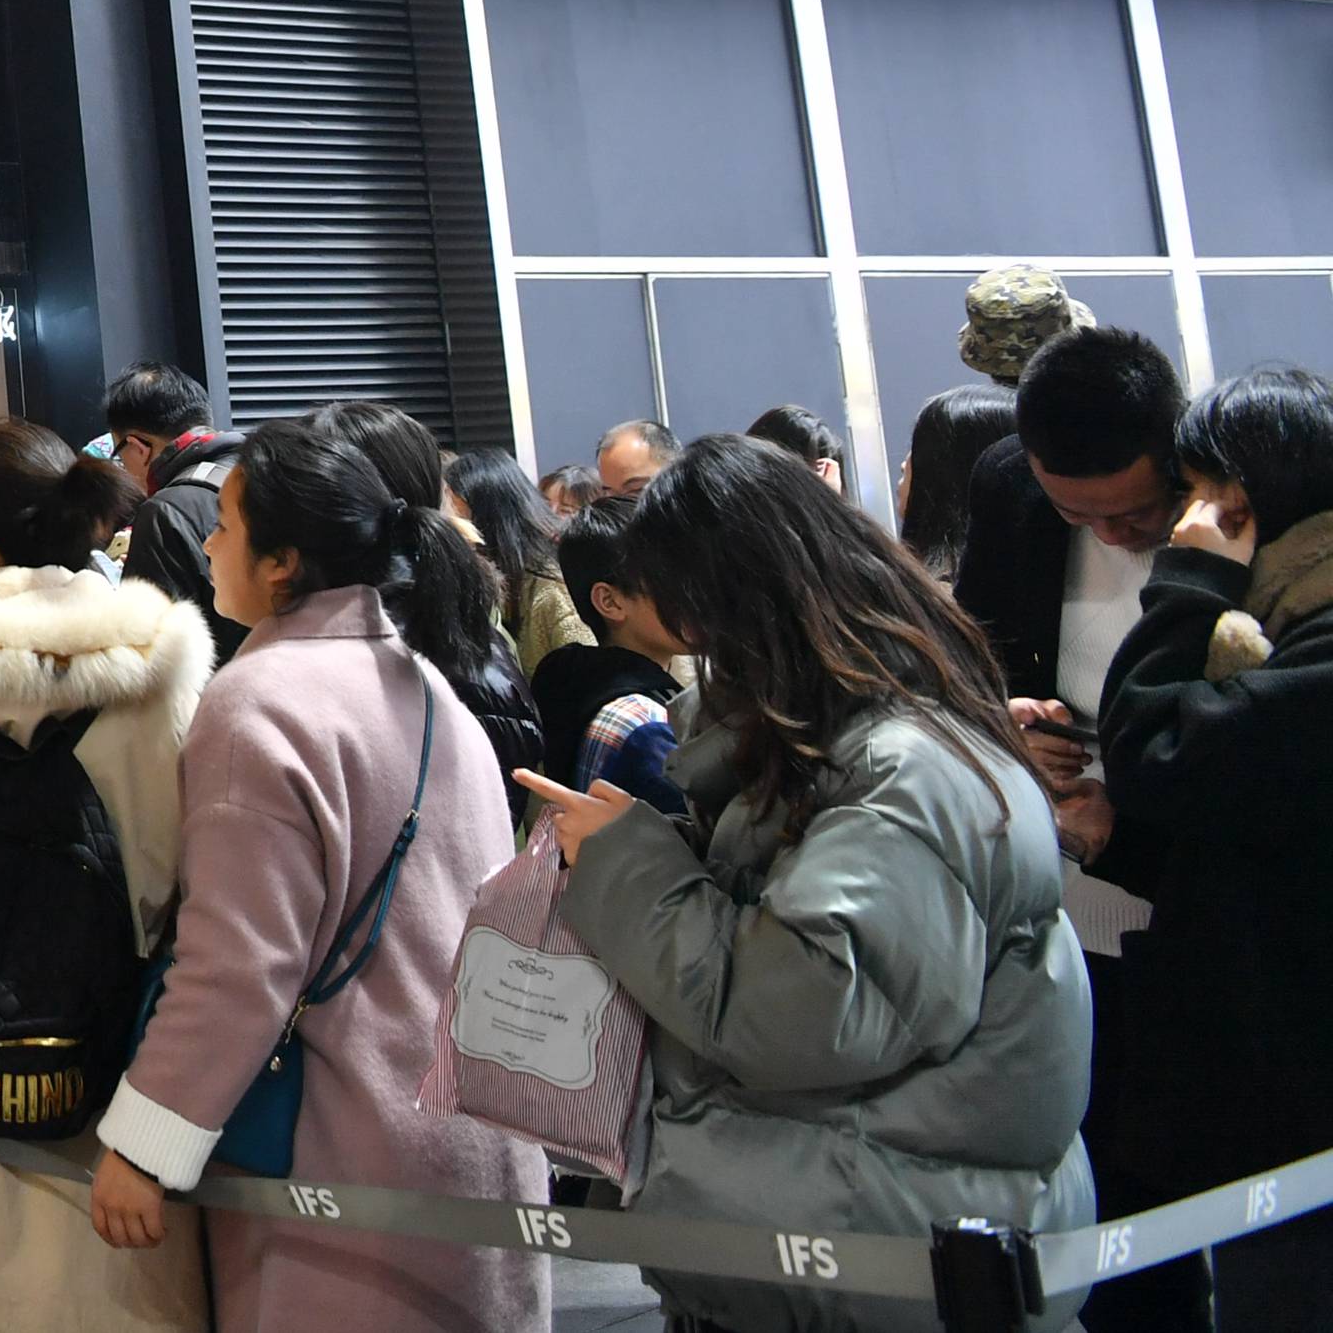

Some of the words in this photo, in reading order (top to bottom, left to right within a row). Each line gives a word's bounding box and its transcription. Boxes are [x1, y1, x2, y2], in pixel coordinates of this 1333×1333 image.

[289, 1184, 341, 1219] IFS
[1246, 1177, 1277, 1224] IFS
[516, 1207, 572, 1248] IFS
[1096, 1225, 1133, 1273] IFS
[776, 1233, 839, 1279] IFS
